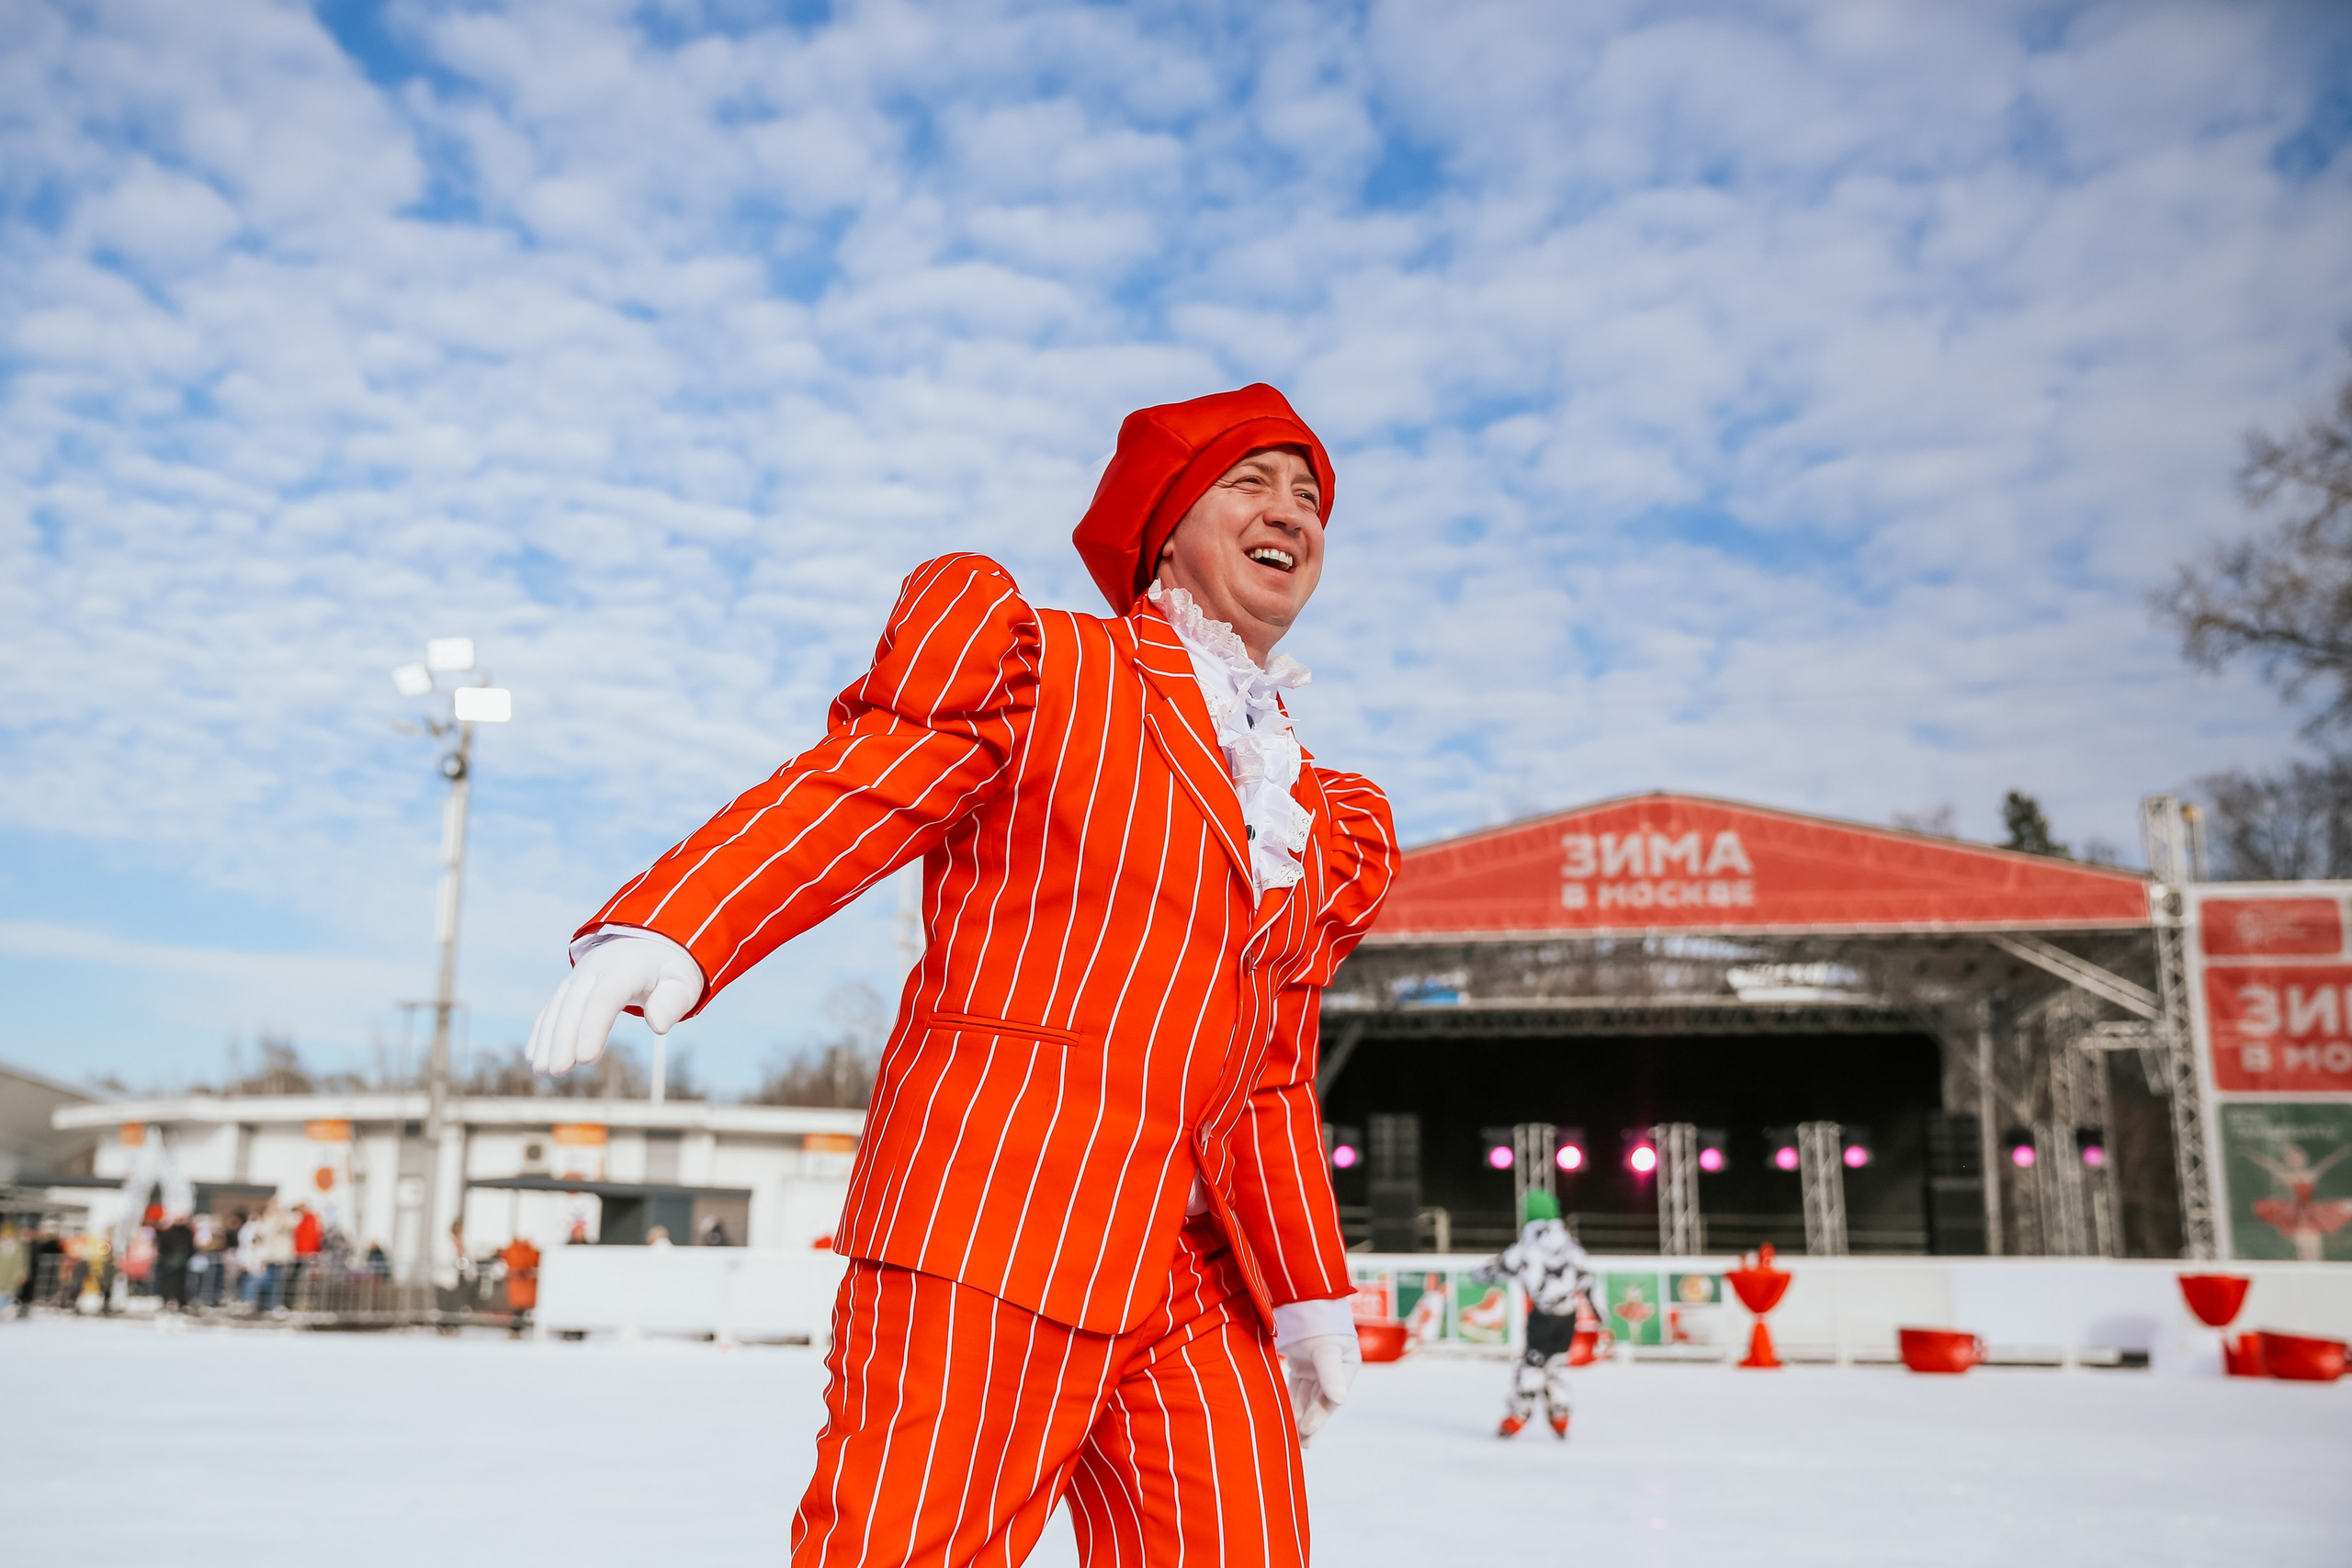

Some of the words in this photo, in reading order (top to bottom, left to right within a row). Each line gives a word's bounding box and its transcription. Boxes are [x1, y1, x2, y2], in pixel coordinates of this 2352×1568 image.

[1561, 829, 1753, 878] ЗИМА
[1562, 883, 1589, 909] В
[1598, 878, 1756, 909] МОСКВЕ
[2236, 983, 2352, 1037] ЗИ
[2242, 1043, 2272, 1073] В
